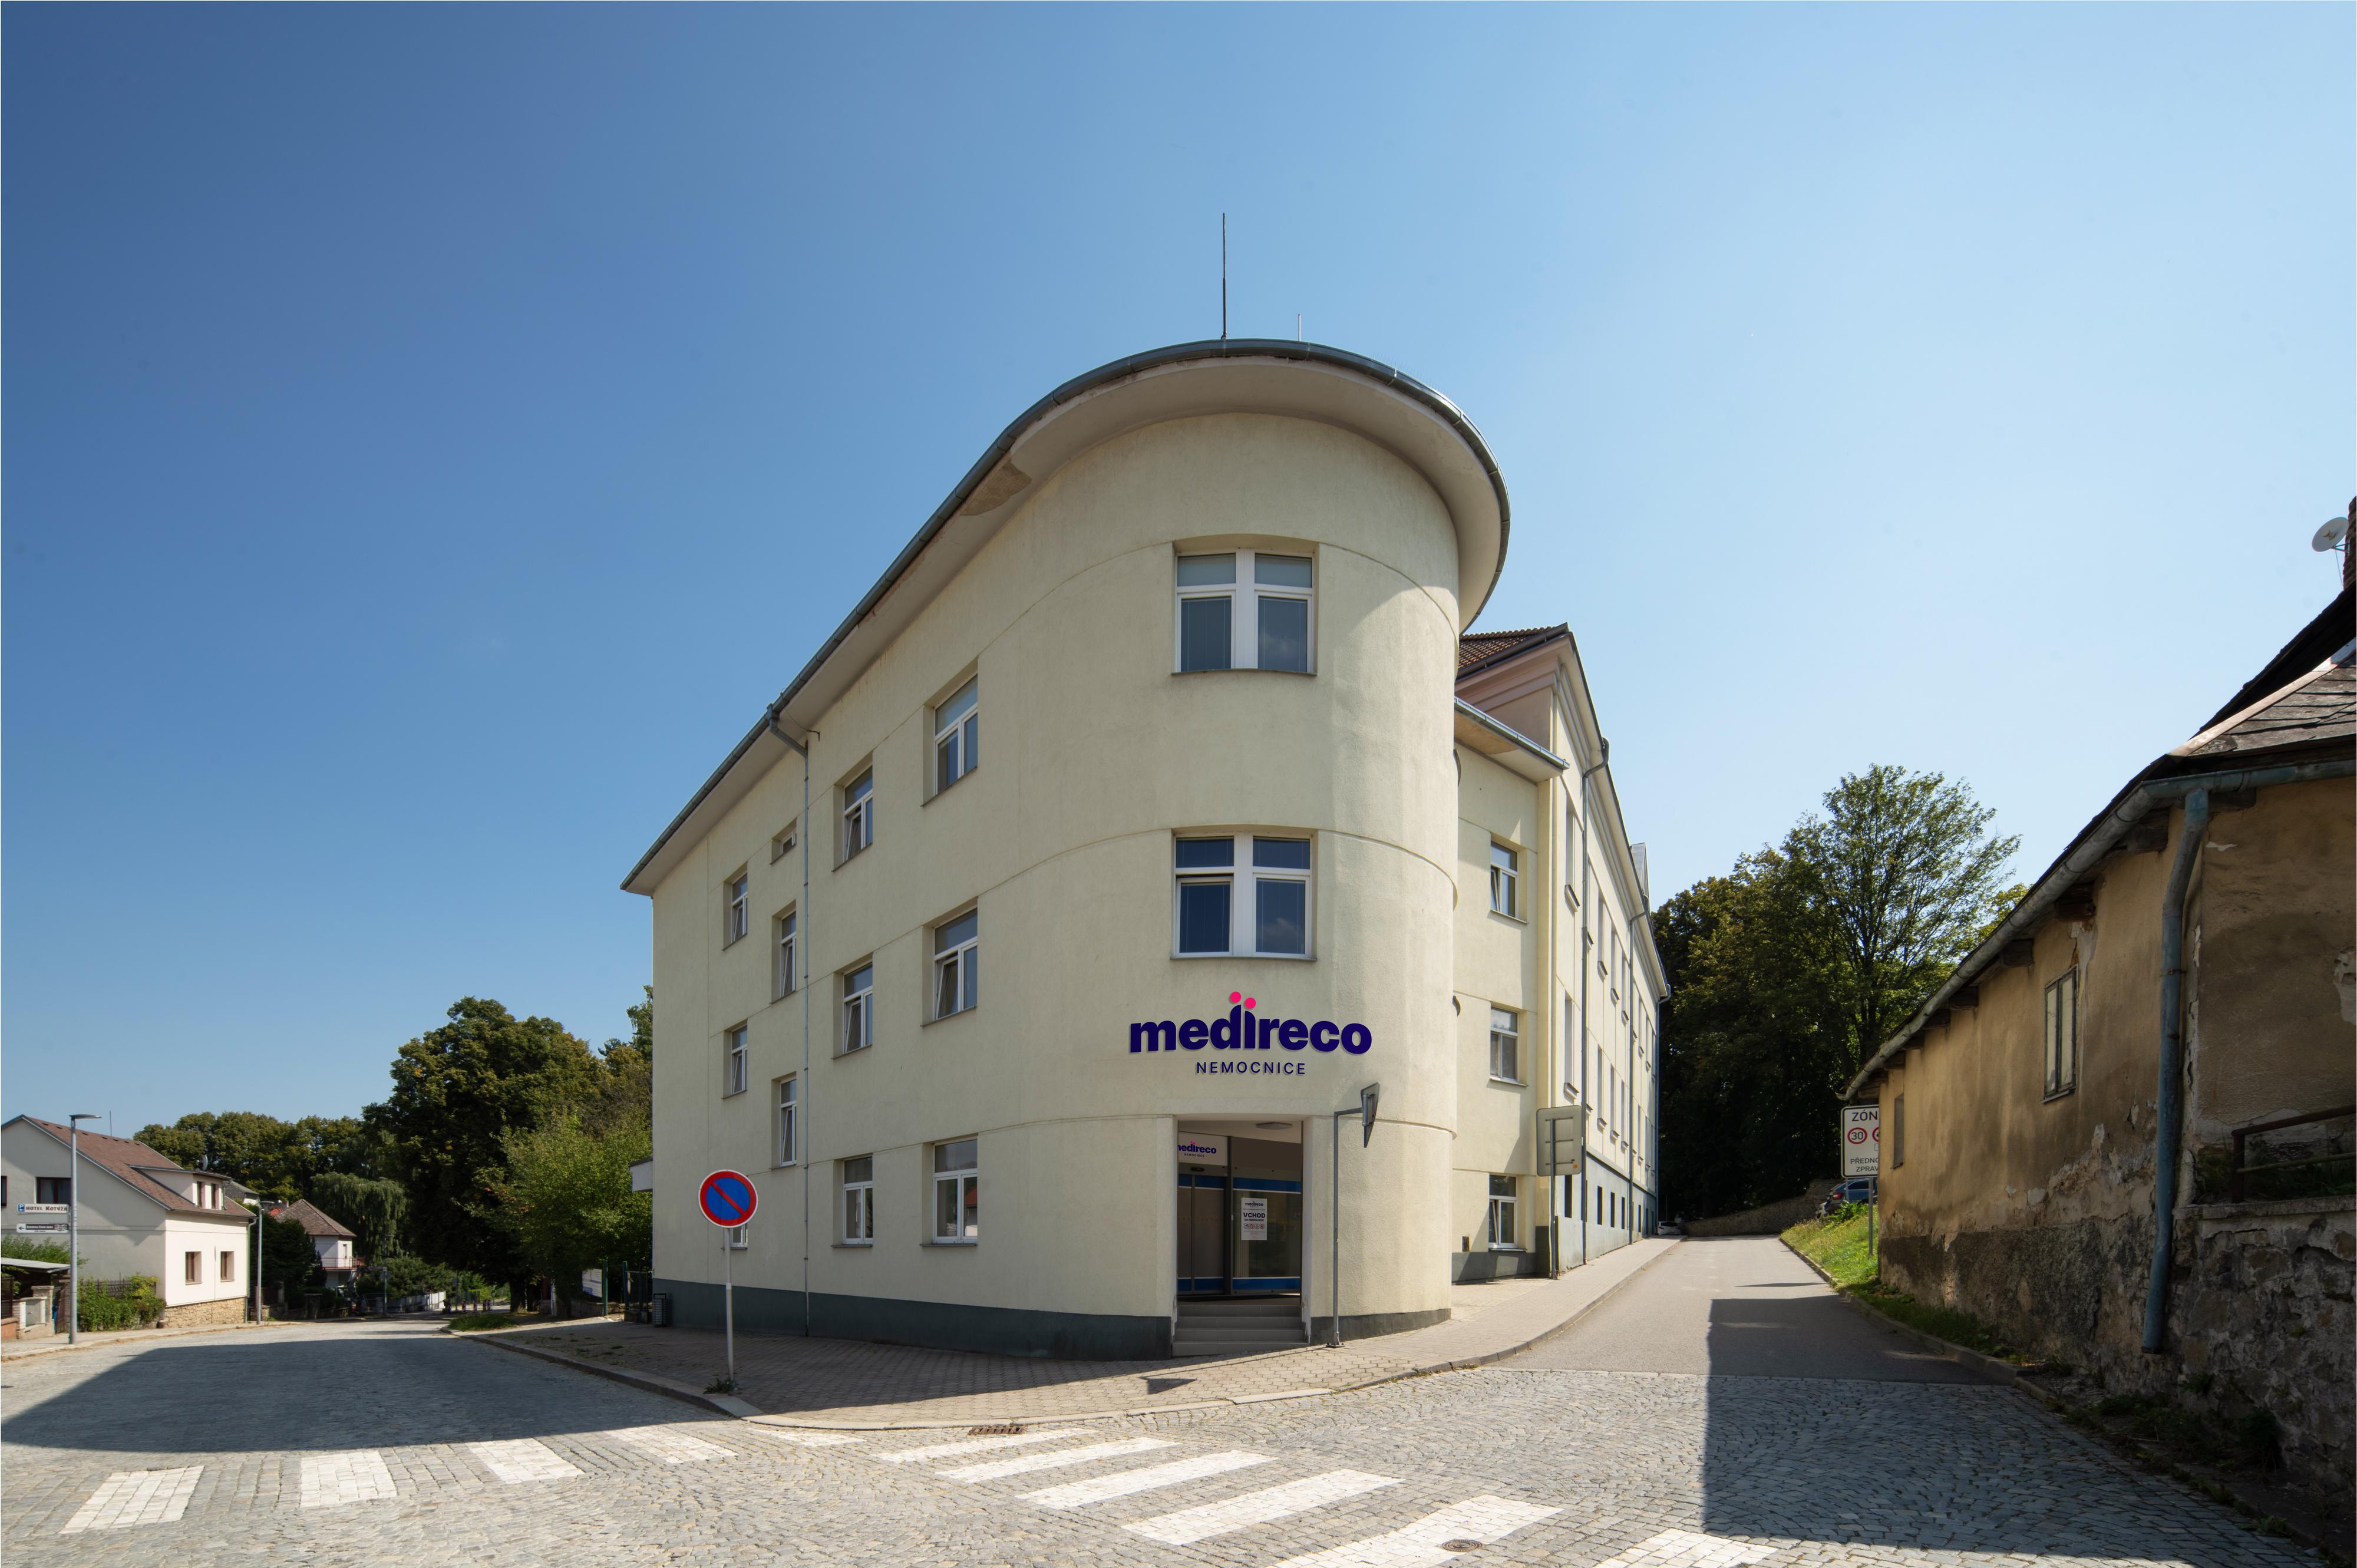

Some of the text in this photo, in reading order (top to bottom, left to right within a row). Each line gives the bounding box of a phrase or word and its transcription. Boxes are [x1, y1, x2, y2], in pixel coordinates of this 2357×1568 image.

[1130, 992, 1372, 1055] medireco
[1196, 1061, 1306, 1075] NEMOCNICE
[1851, 1110, 1878, 1121] ZÓN
[1851, 1132, 1863, 1140] 30
